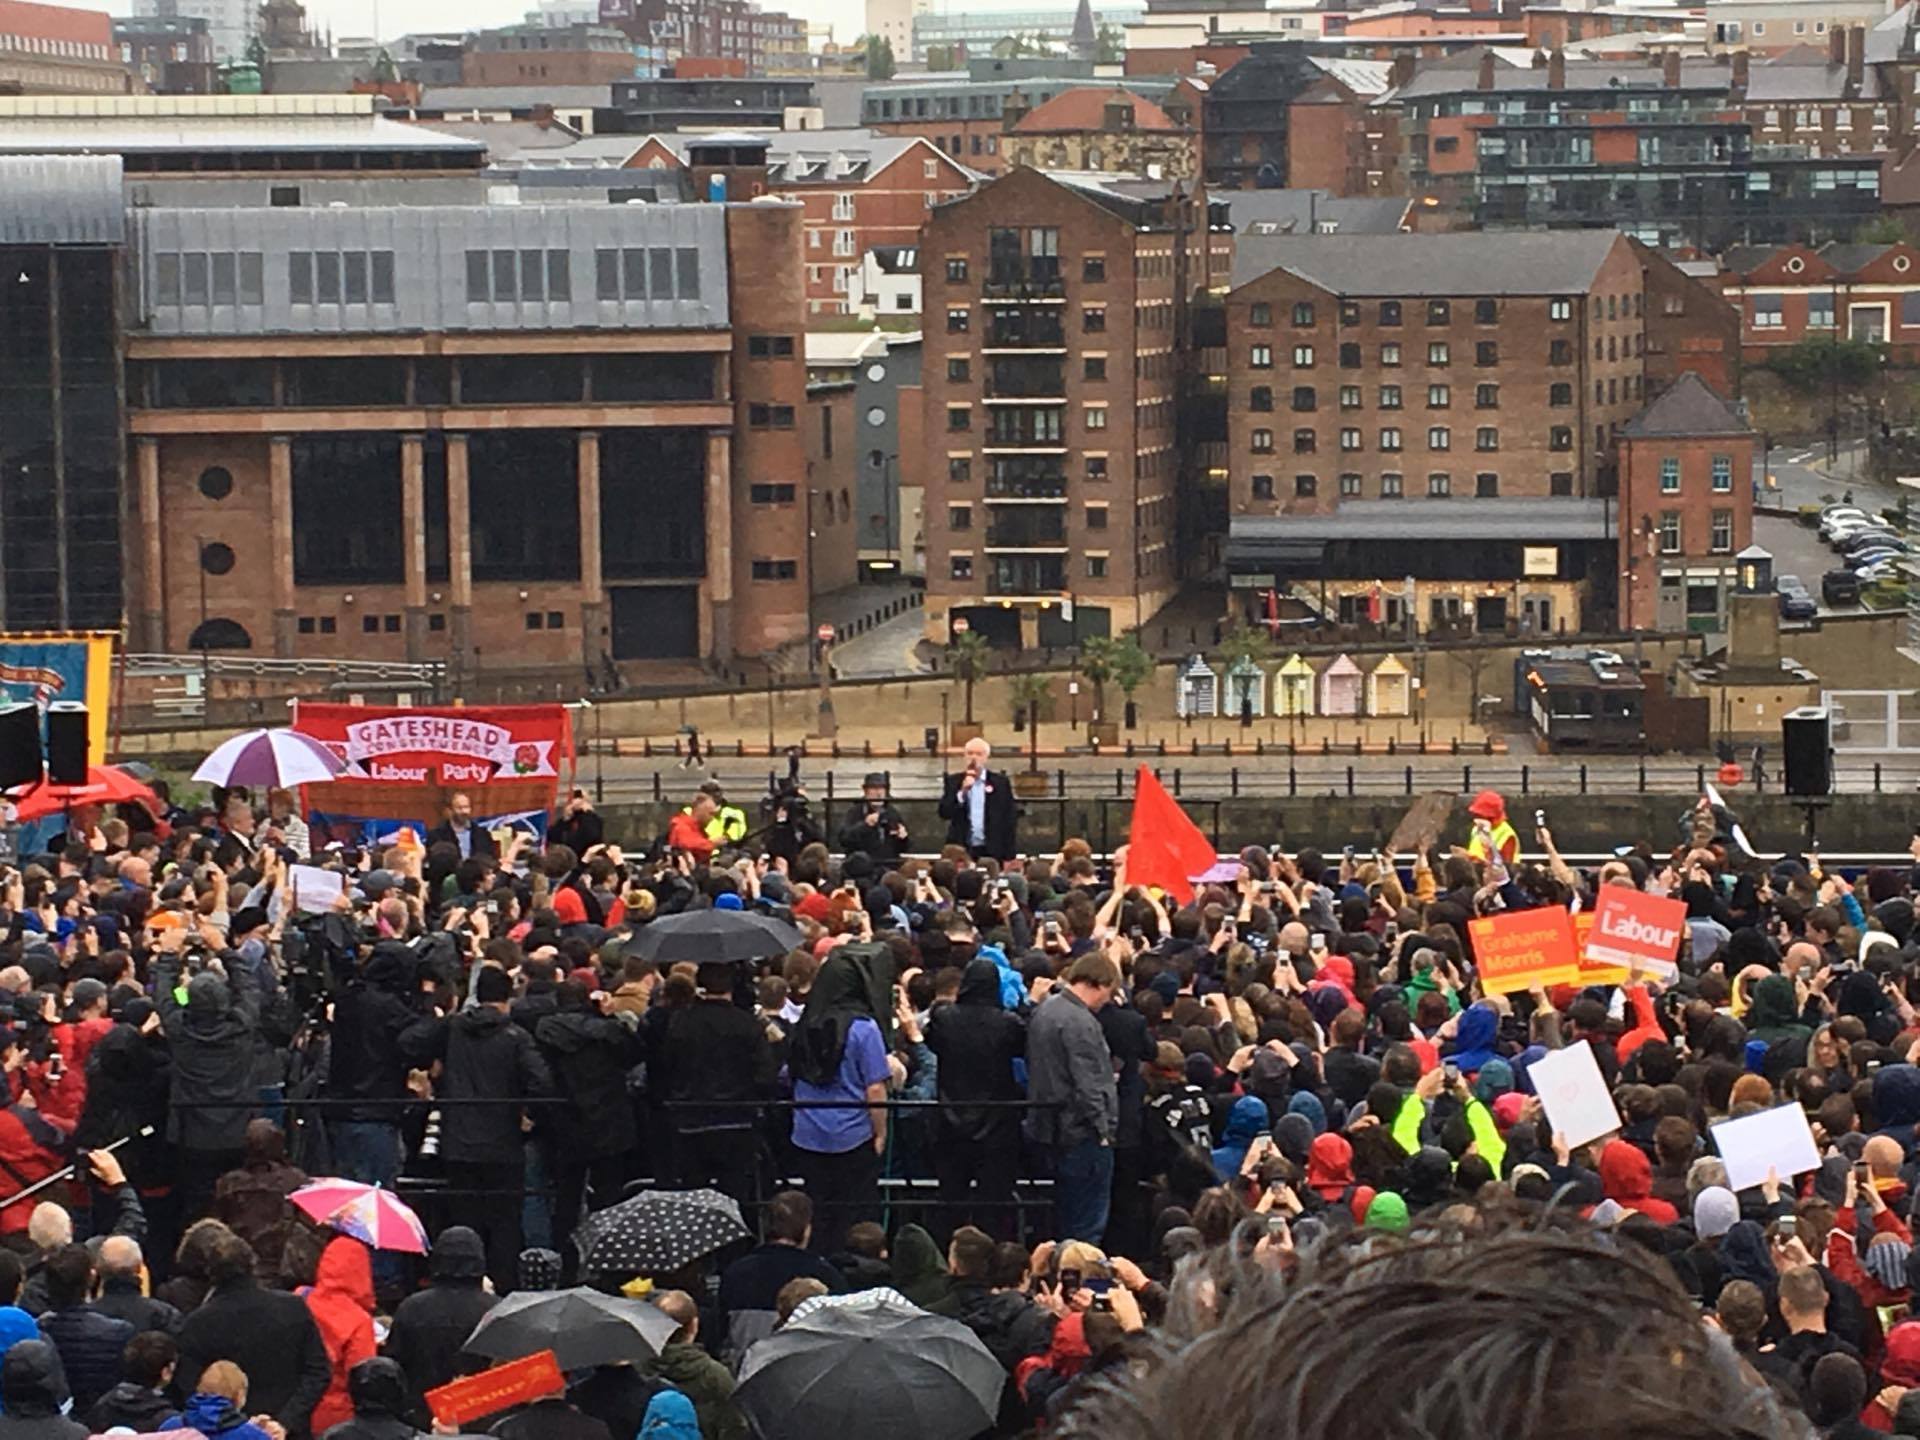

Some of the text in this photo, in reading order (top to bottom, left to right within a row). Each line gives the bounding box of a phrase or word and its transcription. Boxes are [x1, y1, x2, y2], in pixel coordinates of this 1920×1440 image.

[359, 720, 500, 745] GATESHEAD
[370, 762, 490, 783] Labour Party
[1481, 928, 1559, 953] Grahame
[1600, 909, 1680, 949] Labour
[1484, 949, 1545, 972] Morris
